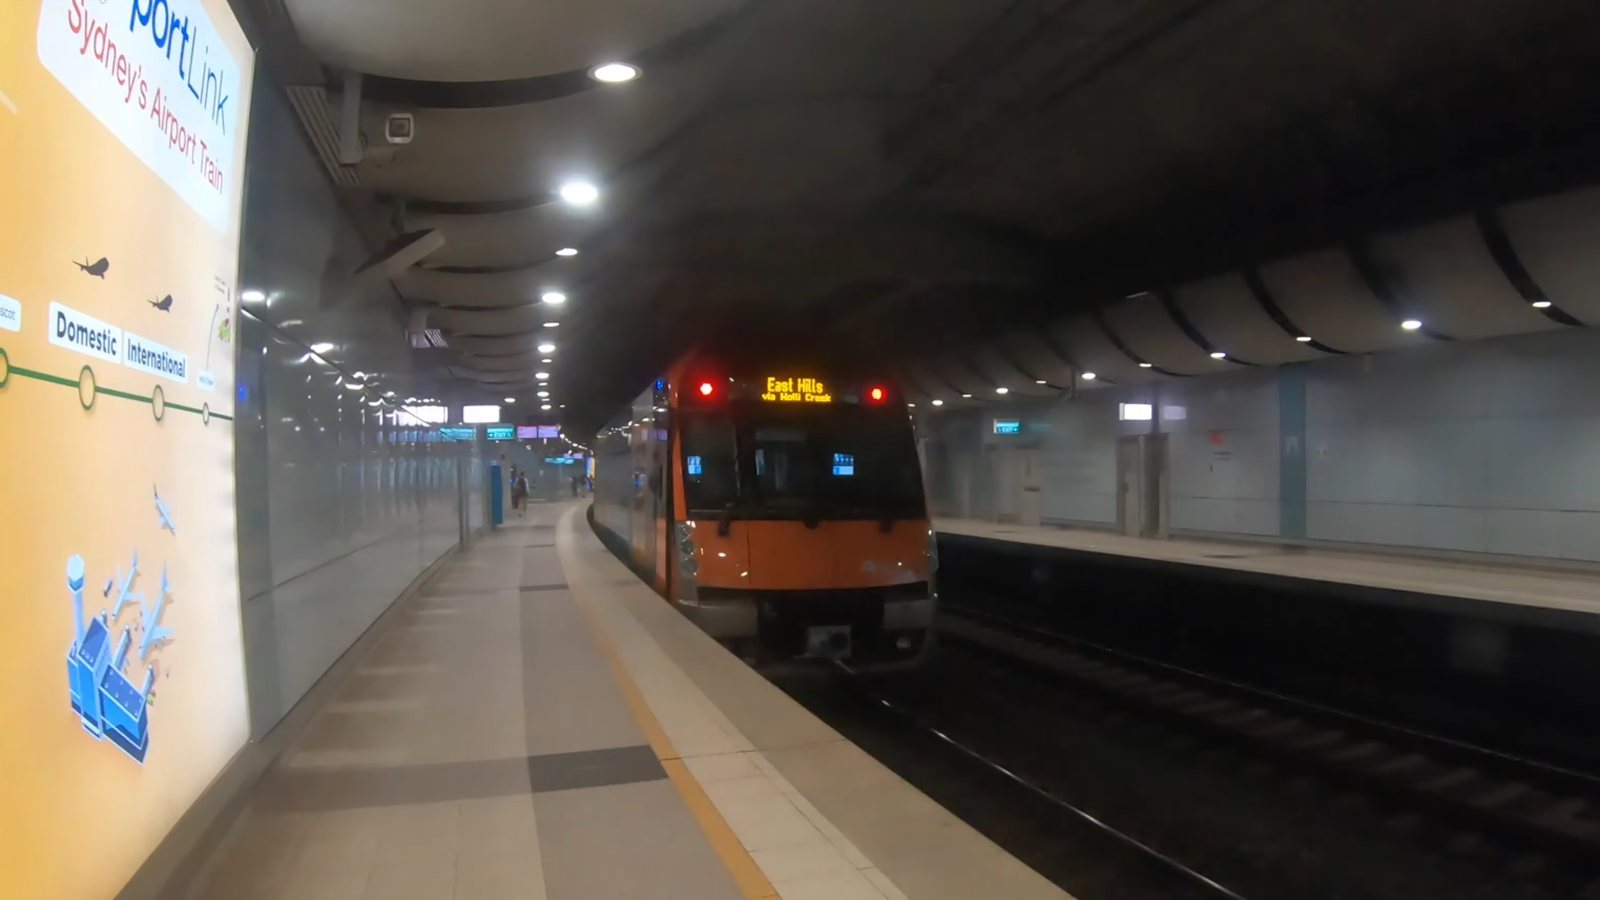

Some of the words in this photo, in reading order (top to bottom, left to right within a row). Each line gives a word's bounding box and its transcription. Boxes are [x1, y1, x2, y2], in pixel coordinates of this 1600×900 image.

[150, 88, 197, 165] Airport
[199, 139, 223, 194] Train
[56, 311, 117, 356] Domestic
[127, 338, 186, 378] International
[761, 392, 776, 401] via
[805, 393, 832, 402] Creek
[767, 377, 793, 393] East
[797, 378, 824, 393] Hills
